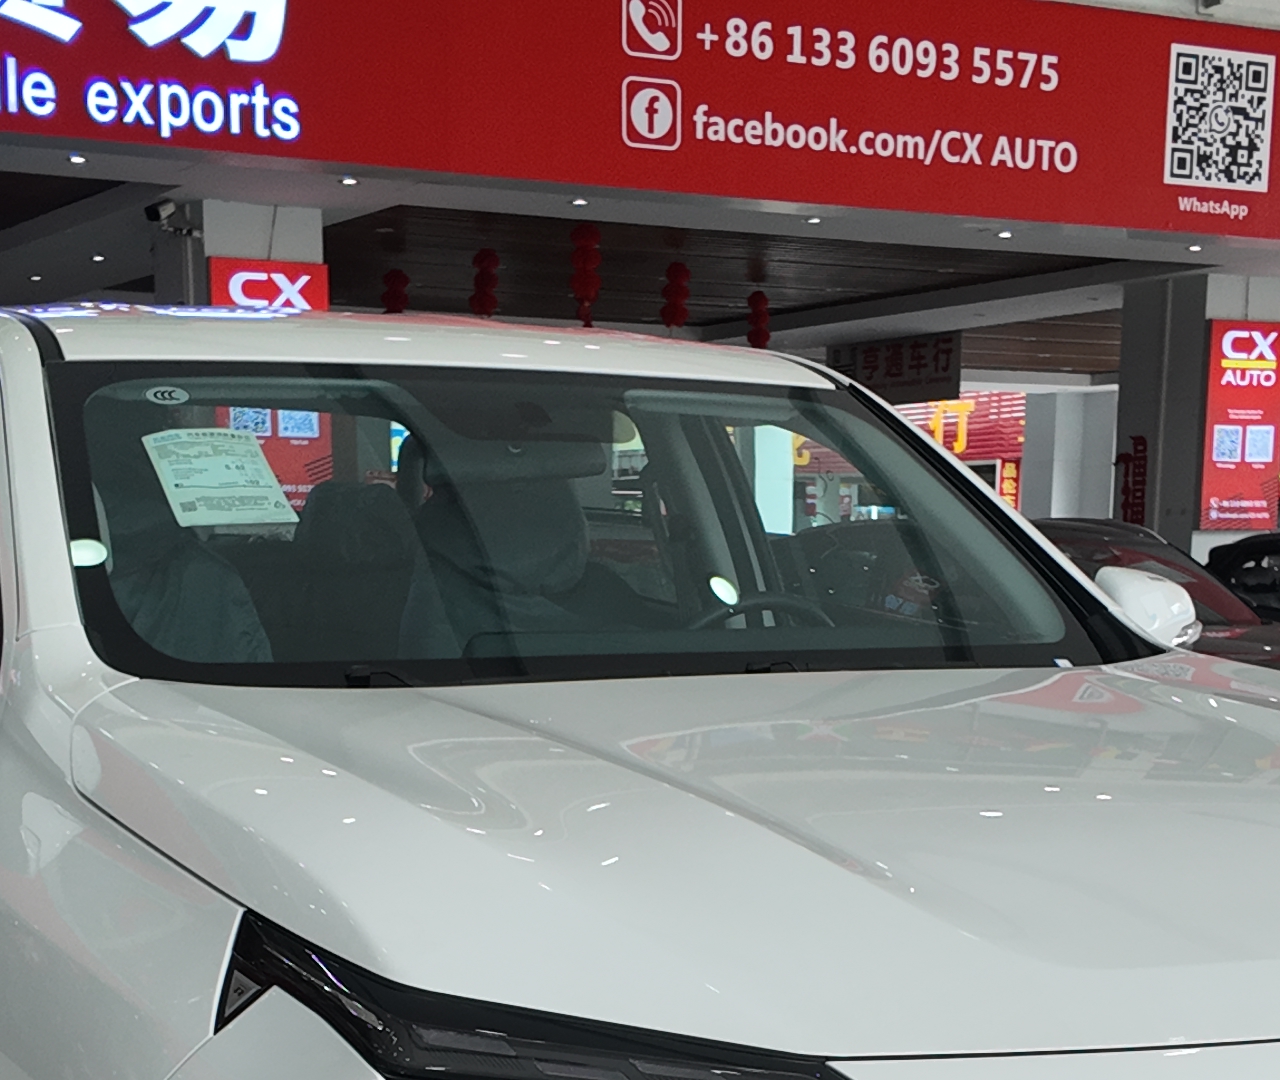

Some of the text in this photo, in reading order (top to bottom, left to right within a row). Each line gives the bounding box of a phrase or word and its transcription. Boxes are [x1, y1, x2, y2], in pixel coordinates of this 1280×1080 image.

[696, 17, 1059, 91] +86 133 6093 5575
[86, 76, 300, 139] exports
[693, 104, 1078, 173] facebook.com/CX AUTO
[1178, 197, 1248, 220] WhatsApp
[228, 271, 313, 310] CX
[1221, 330, 1279, 361] CX
[1220, 369, 1276, 387] AUTO
